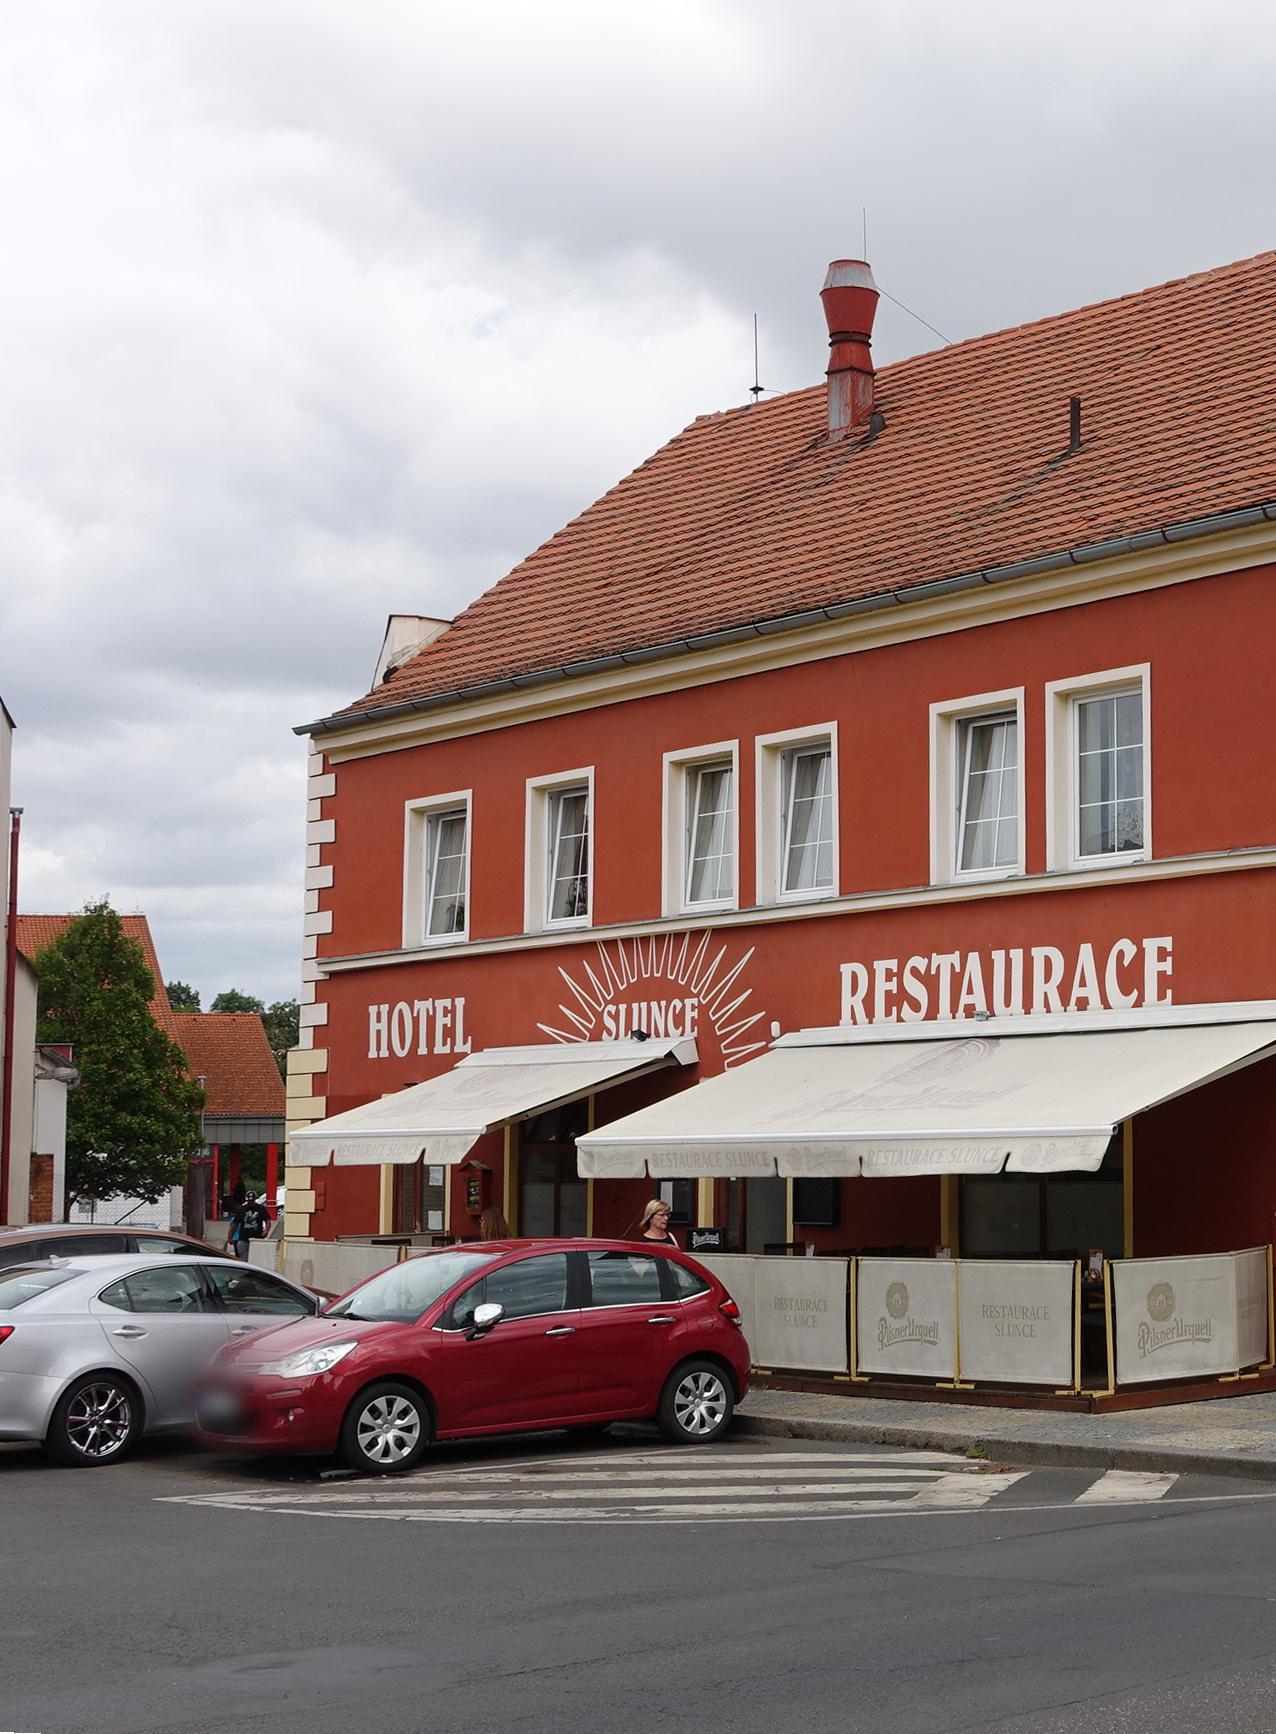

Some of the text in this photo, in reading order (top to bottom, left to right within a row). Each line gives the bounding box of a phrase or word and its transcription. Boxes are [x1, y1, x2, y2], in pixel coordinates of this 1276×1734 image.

[839, 935, 1173, 1026] RESTAURACE
[367, 996, 472, 1060] HOTEL
[602, 998, 699, 1041] SLUNCE
[652, 1152, 724, 1169] RESTAURACE
[726, 1151, 770, 1168] SLUNCE
[867, 1146, 1002, 1168] RESTAURACE SLUNCE
[773, 1297, 829, 1313] RESTAURACE
[982, 1304, 1050, 1321] RESTAURACE
[783, 1314, 819, 1328] SLUNCE
[994, 1324, 1037, 1338] SLUNCE
[878, 1316, 940, 1350] Pilsner Urquell
[1138, 1318, 1212, 1358] Pilsner Urquell
